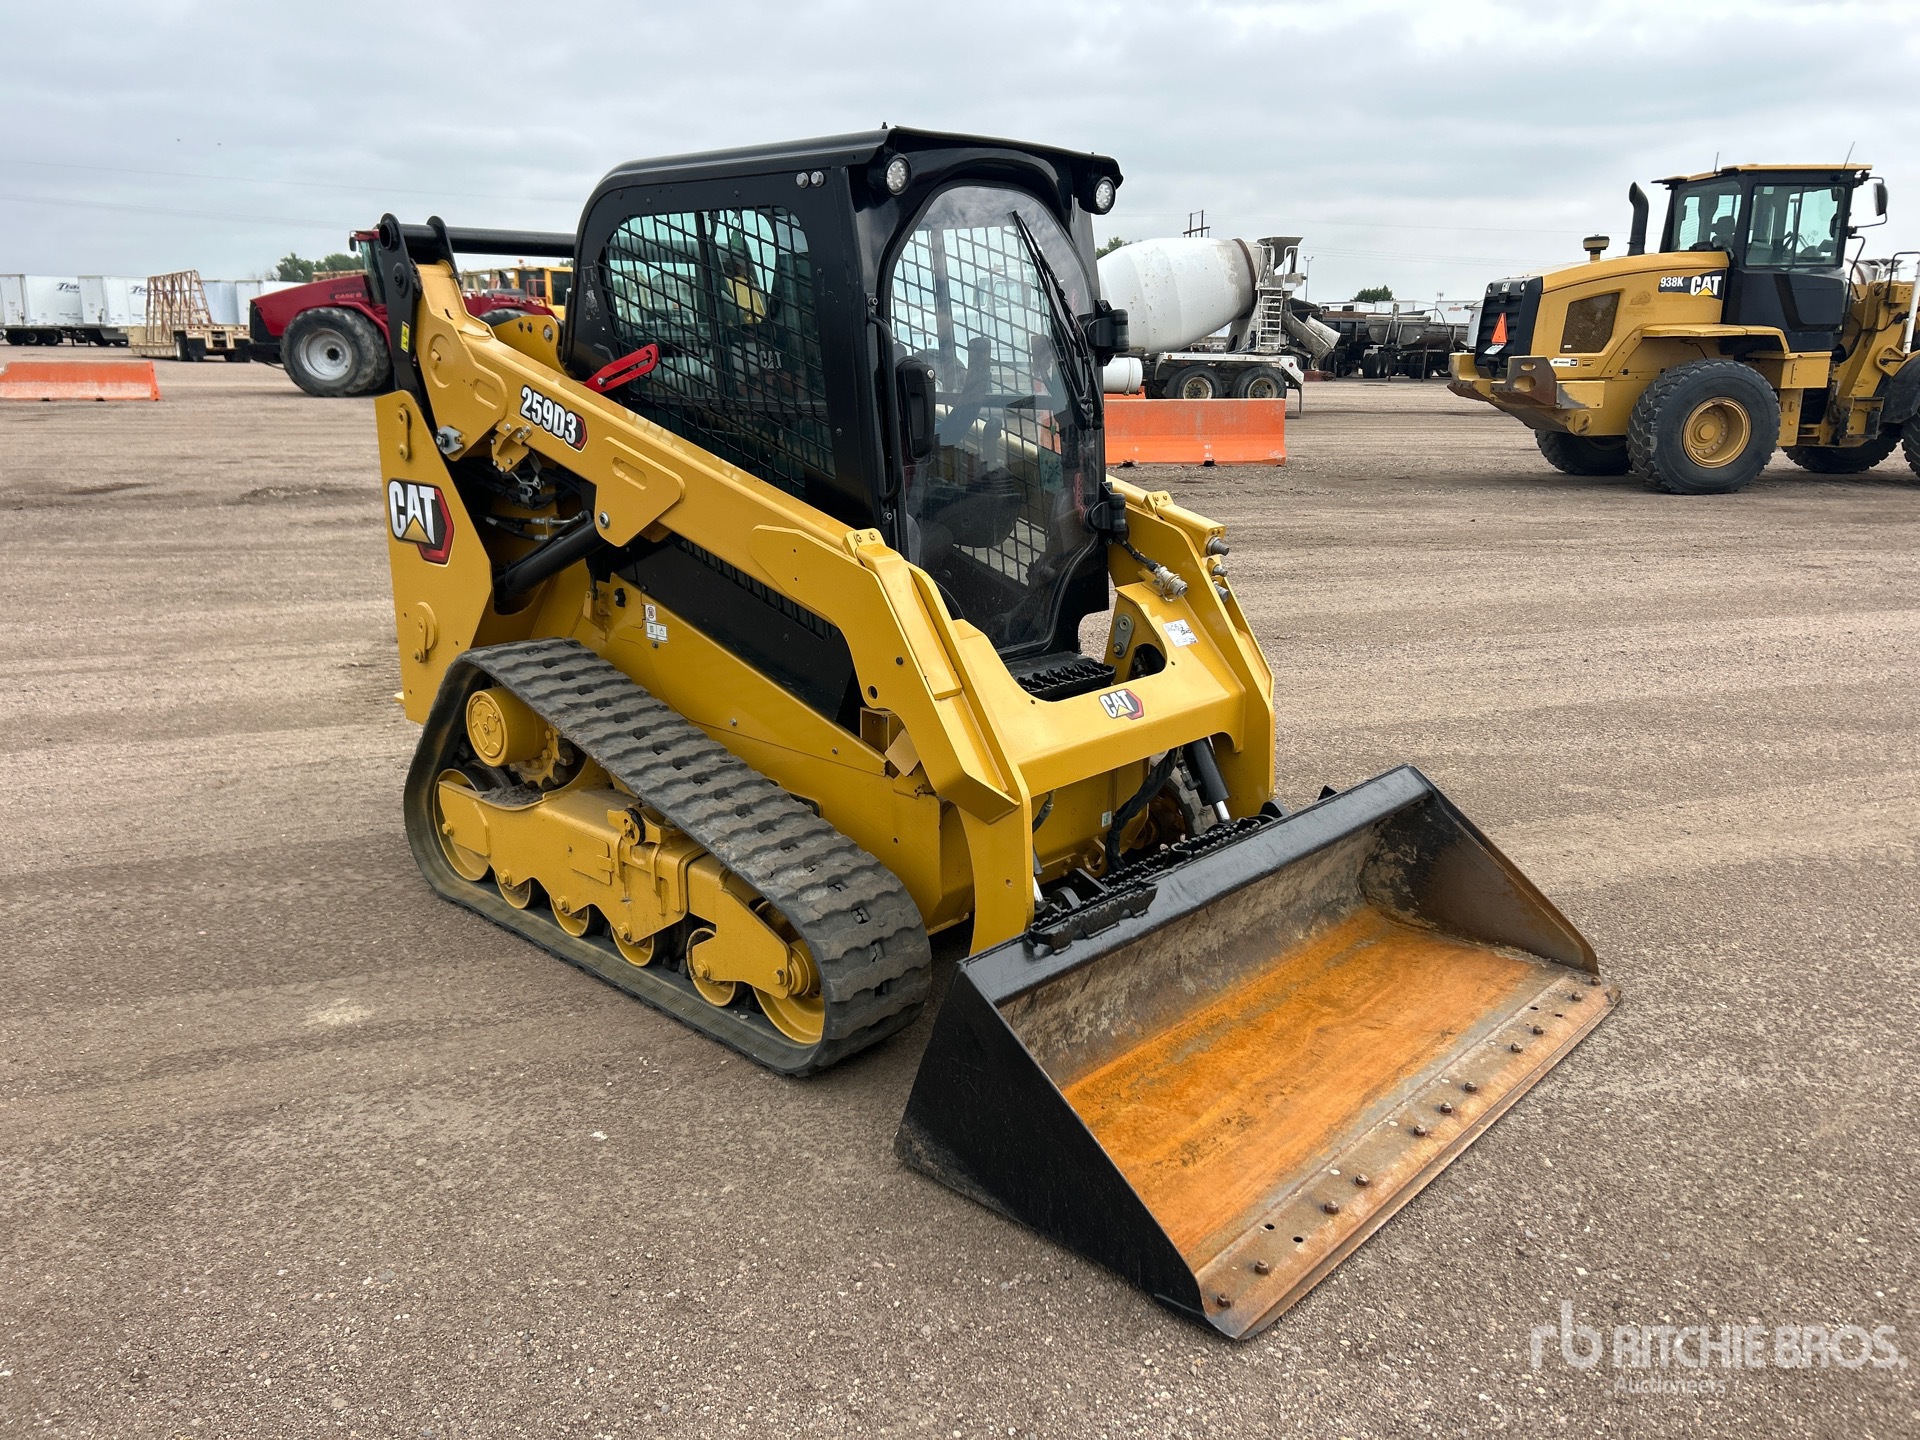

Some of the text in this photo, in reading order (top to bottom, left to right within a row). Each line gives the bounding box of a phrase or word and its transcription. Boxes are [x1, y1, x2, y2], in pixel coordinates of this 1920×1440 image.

[1660, 275, 1722, 296] 938K CAT
[759, 350, 783, 369] CAT
[520, 386, 577, 444] 259D3
[388, 480, 436, 545] CAT
[1099, 689, 1135, 718] CAT
